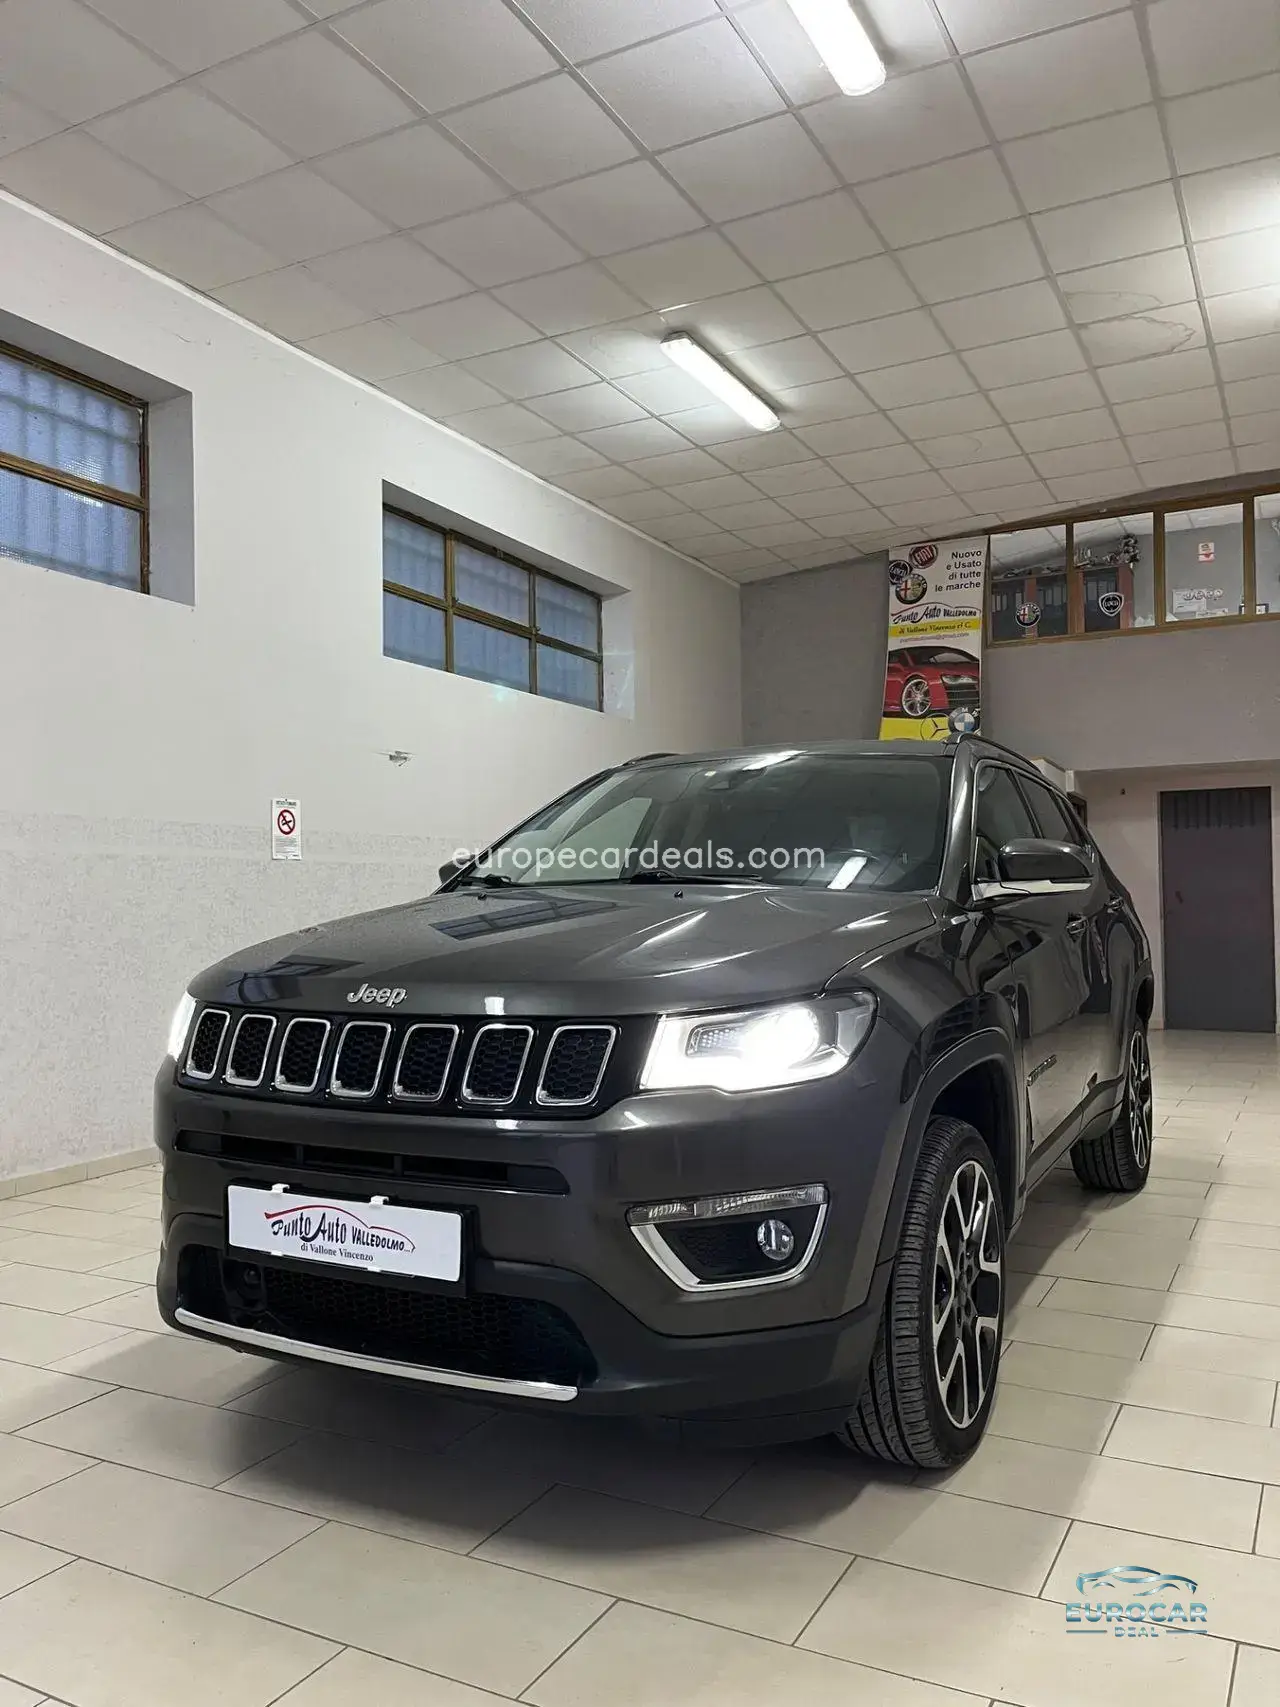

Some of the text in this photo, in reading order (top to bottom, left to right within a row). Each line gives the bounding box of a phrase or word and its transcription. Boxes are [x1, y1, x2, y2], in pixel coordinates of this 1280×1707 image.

[951, 550, 982, 559] Nuovo
[954, 560, 982, 569] Usato
[959, 571, 981, 579] tutte
[945, 581, 981, 591] marche
[347, 983, 407, 1008] Jeep
[271, 1212, 405, 1251] Punto Auto VALLEDOLMO
[300, 1243, 374, 1262] di Vallone Vincenzo
